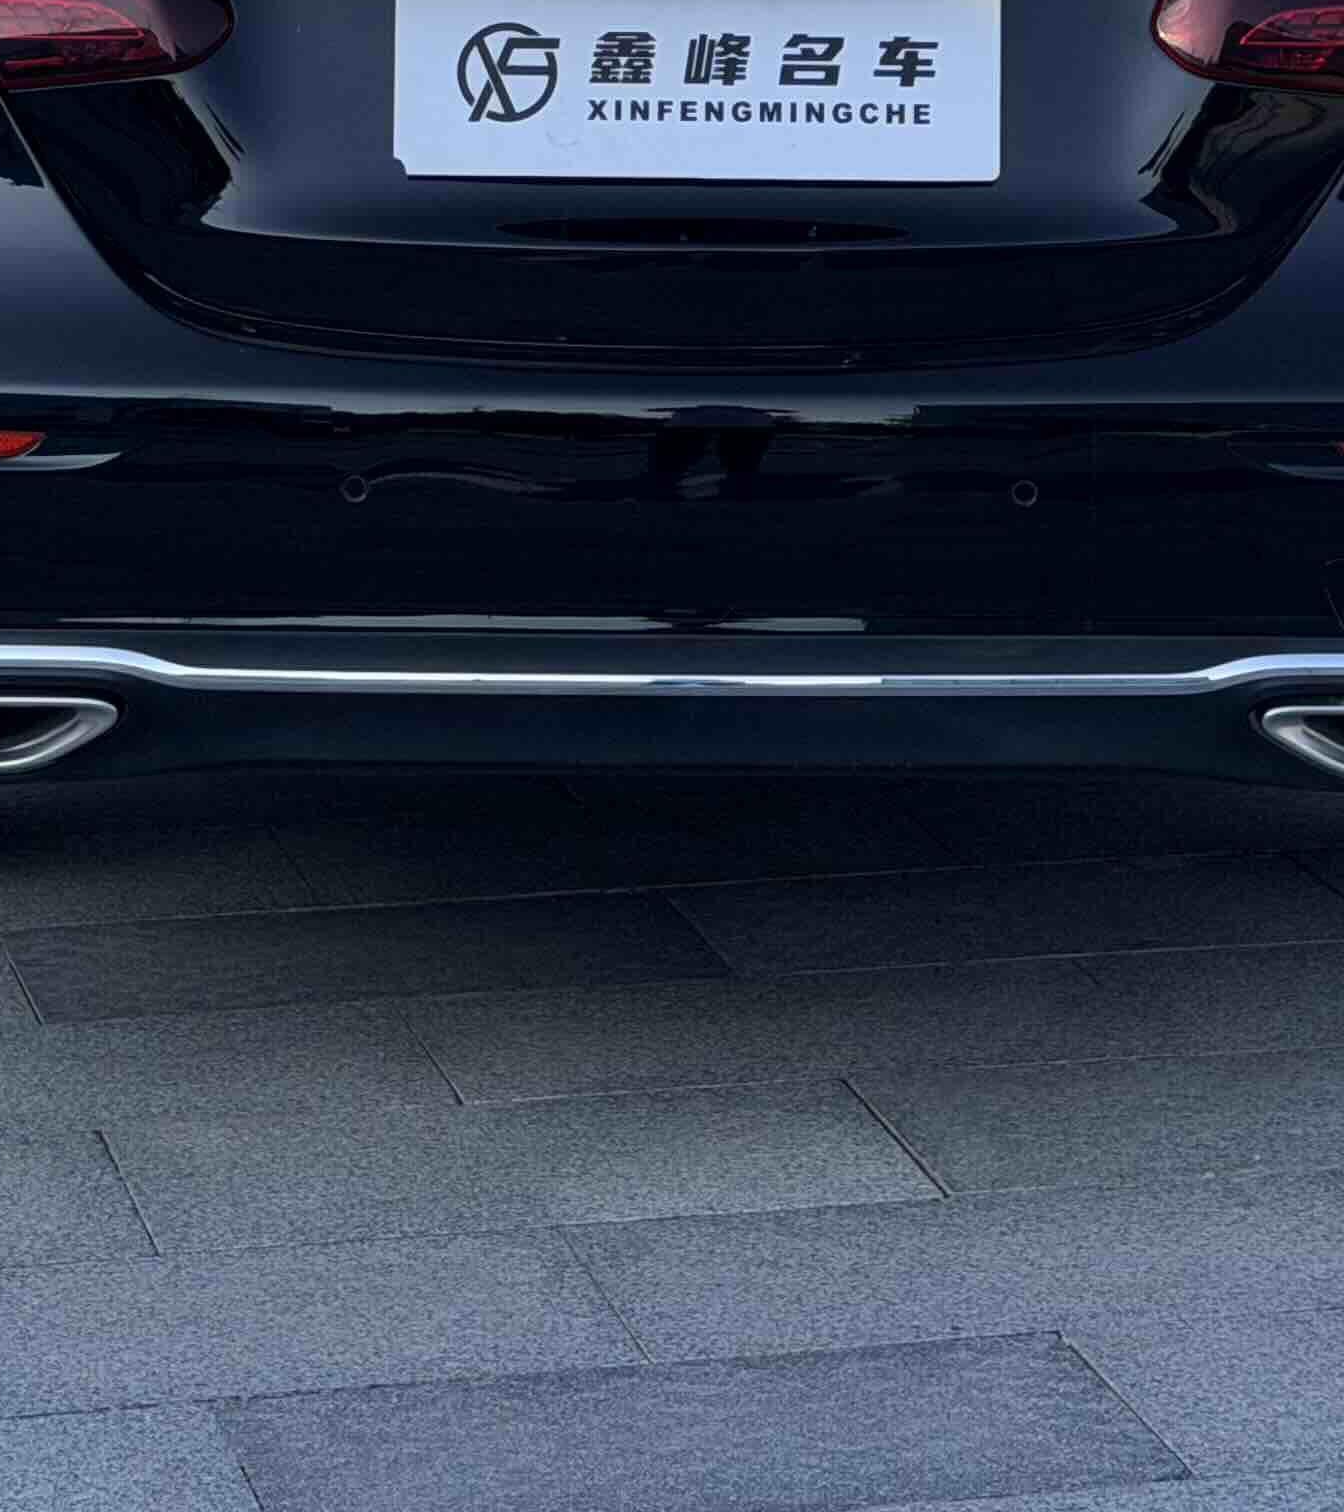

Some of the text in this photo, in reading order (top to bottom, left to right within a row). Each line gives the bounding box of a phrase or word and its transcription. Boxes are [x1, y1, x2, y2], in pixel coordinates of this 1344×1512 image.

[588, 31, 939, 88] 鑫峰名车
[587, 98, 932, 126] XINFENGMINGCHE
